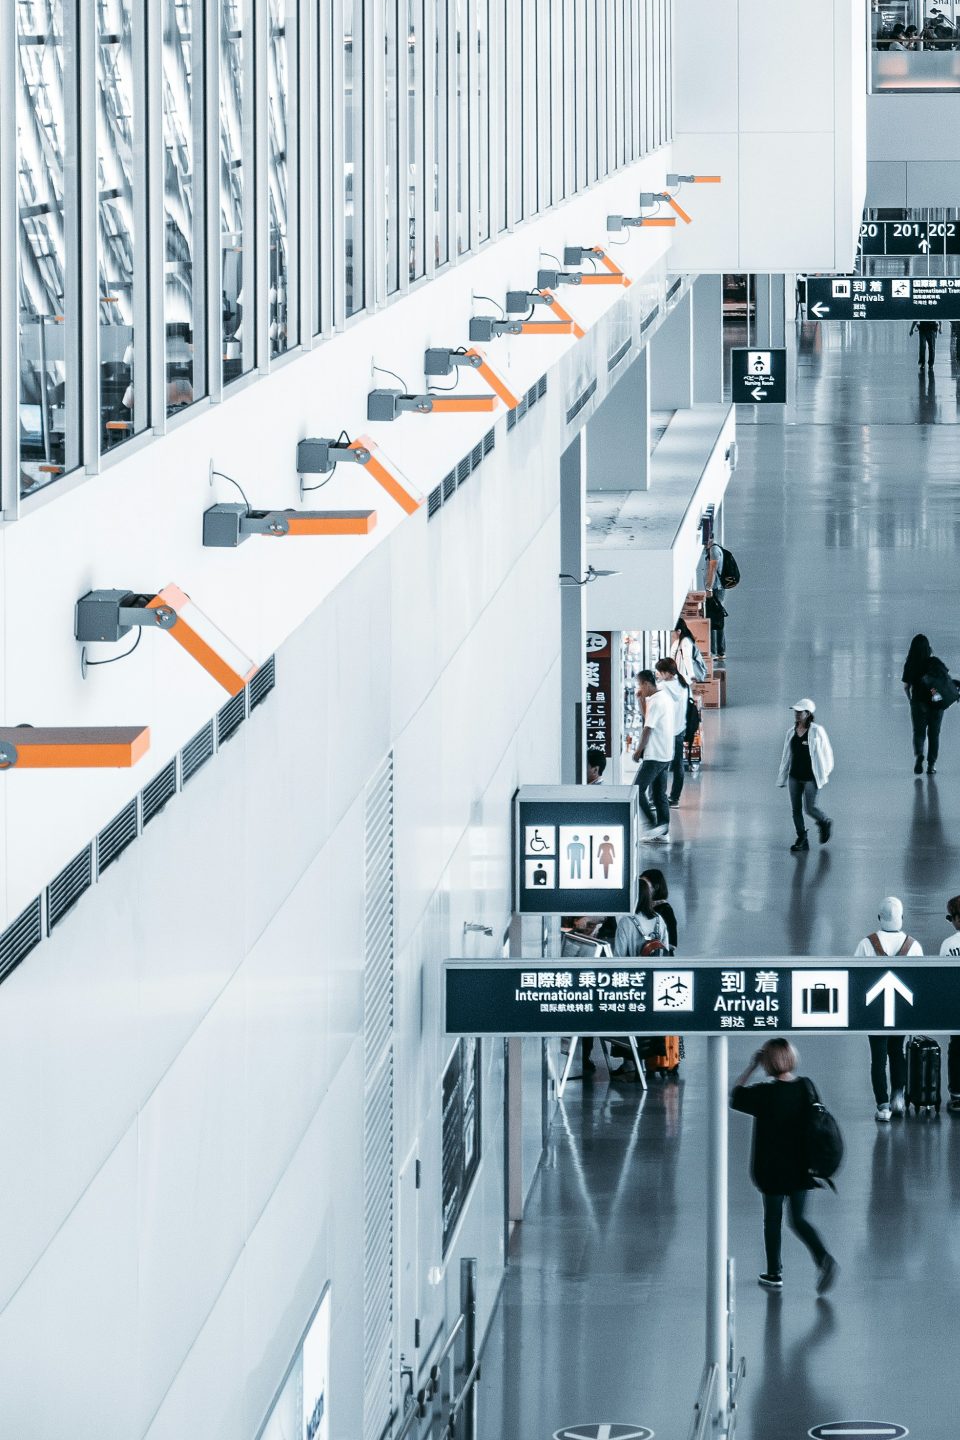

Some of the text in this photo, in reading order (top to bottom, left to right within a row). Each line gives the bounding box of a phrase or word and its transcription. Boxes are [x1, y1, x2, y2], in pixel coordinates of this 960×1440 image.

[853, 293, 884, 302] Arrivals
[520, 971, 647, 988] 国際線 乗り継ぎ
[515, 989, 647, 1001] International Transfer
[713, 995, 779, 1012] Arrivals
[720, 1015, 745, 1028] 到达
[753, 1015, 779, 1028] 도착
